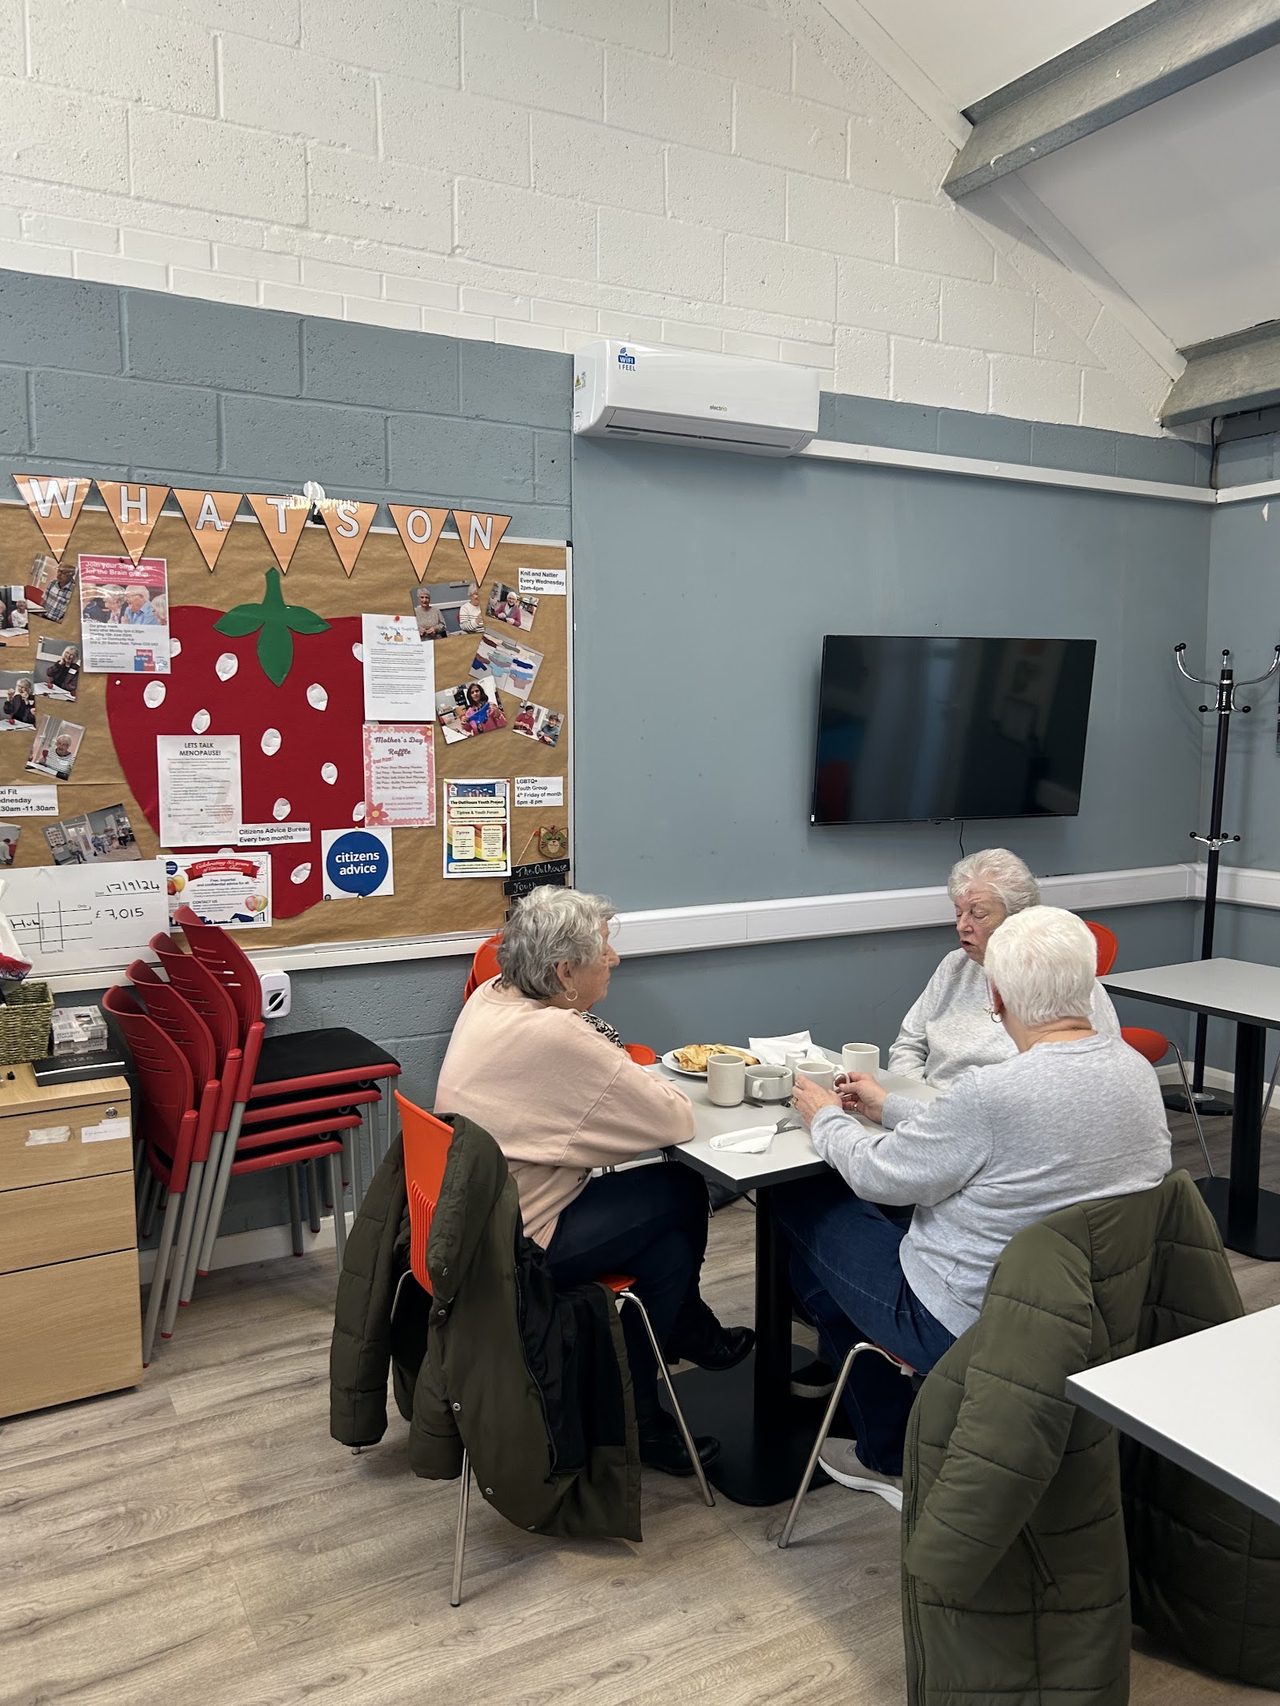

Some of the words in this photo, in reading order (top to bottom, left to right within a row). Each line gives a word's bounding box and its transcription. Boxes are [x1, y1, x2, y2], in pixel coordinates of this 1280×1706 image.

[535, 578, 564, 586] Wednesday
[408, 736, 424, 745] Day
[387, 748, 411, 757] Raffle
[335, 852, 380, 863] citizens
[339, 864, 377, 876] advice
[106, 879, 160, 893] 17/9/24
[96, 910, 101, 919] £
[105, 907, 144, 920] 7,015
